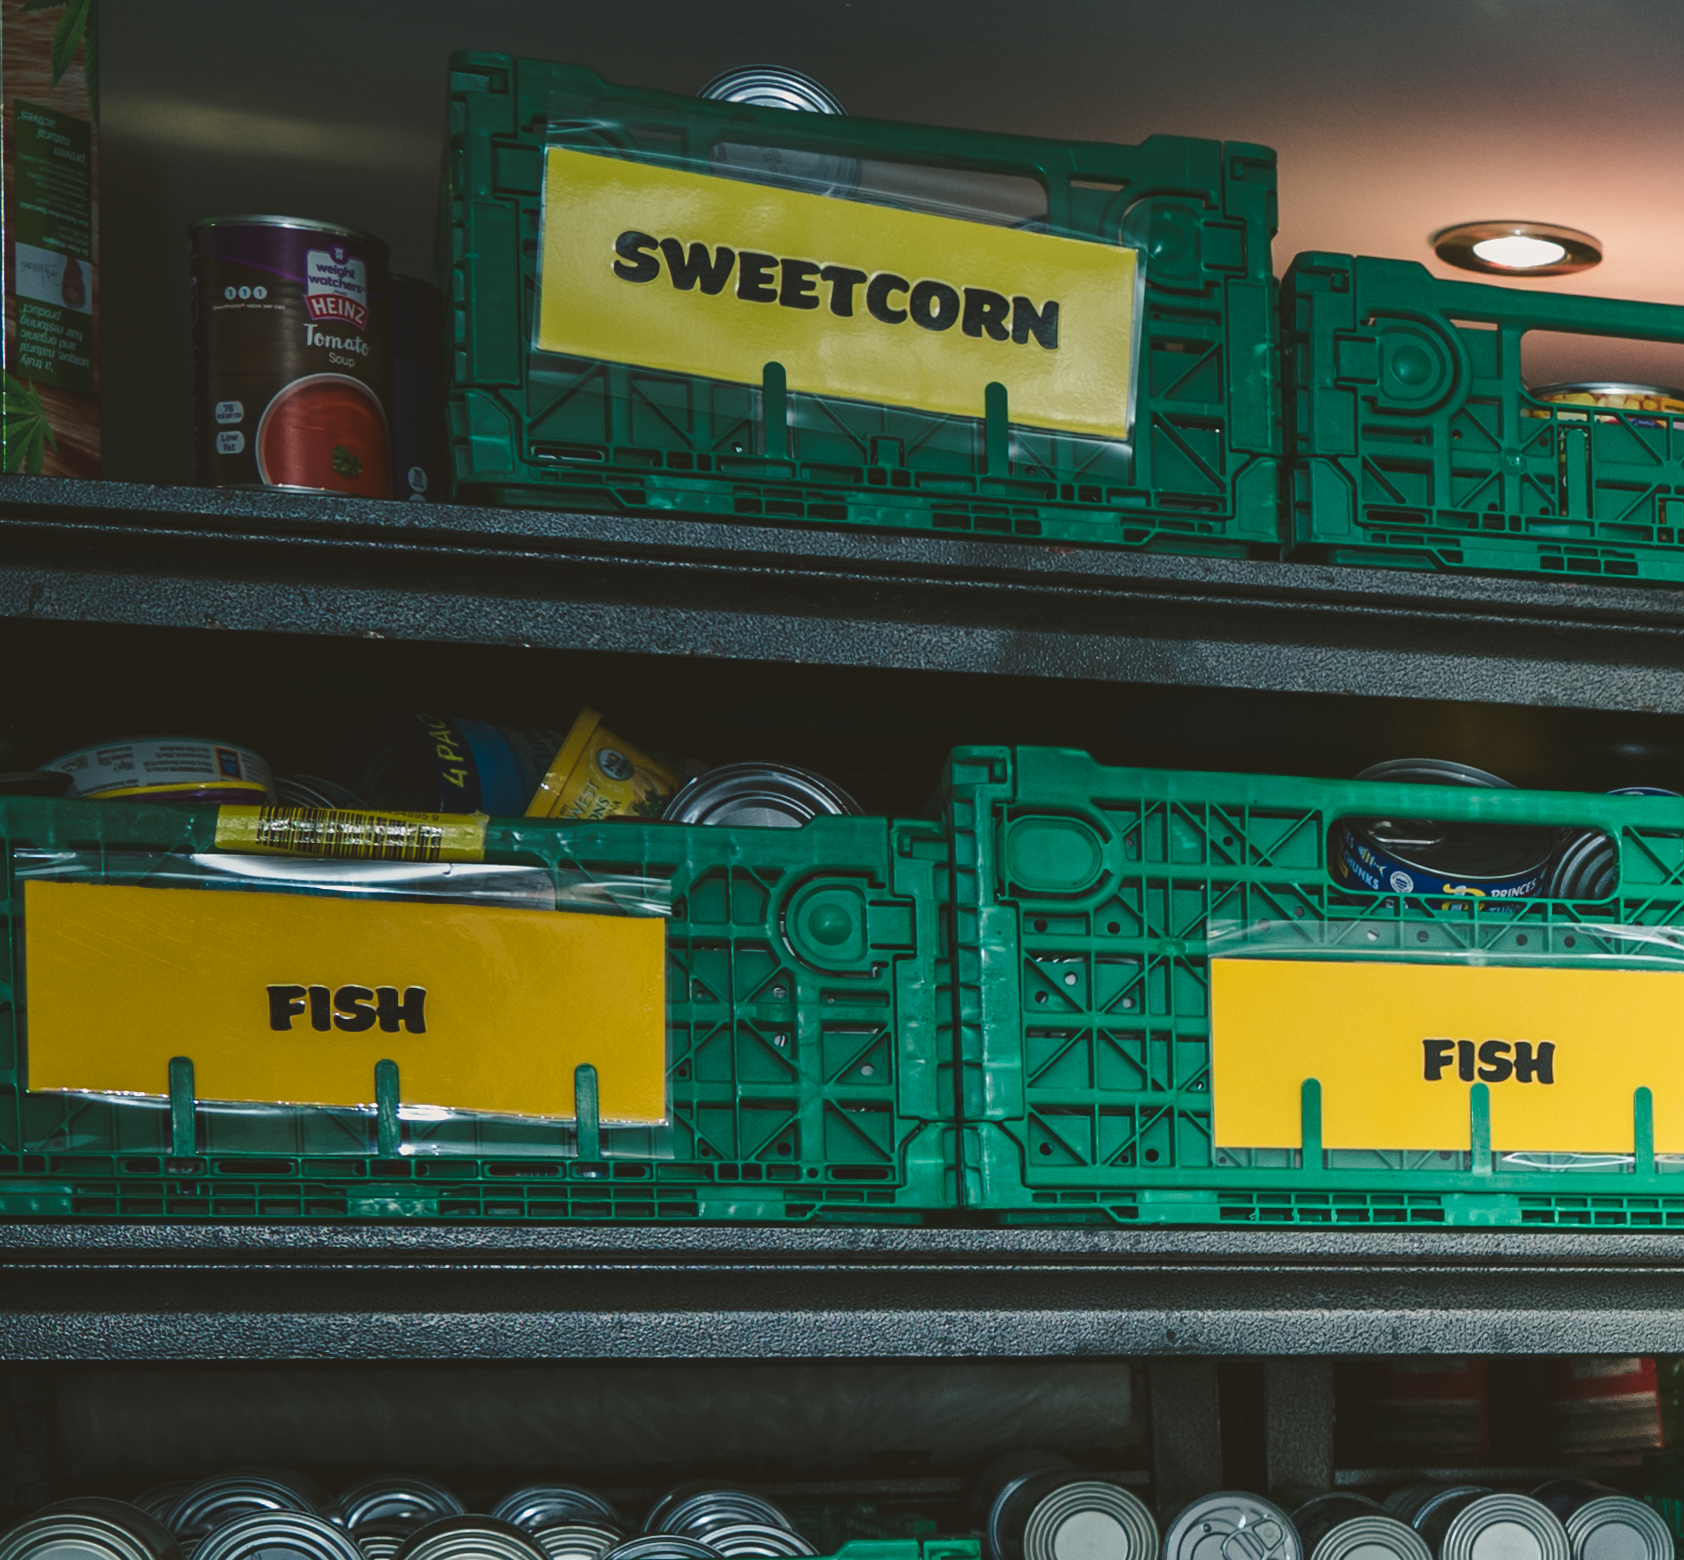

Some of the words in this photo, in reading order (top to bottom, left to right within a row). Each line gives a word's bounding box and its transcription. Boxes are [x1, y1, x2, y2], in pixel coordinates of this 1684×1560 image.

[36, 129, 70, 147] natural
[316, 262, 355, 279] weight
[308, 274, 362, 294] watchers
[612, 230, 1060, 350] SWEETCORN
[312, 299, 366, 325] HEINZ
[20, 314, 64, 336] restoring
[20, 328, 57, 347] organic
[58, 340, 76, 352] and
[64, 330, 83, 342] hair
[303, 323, 370, 356] Tomato
[20, 342, 56, 359] natural
[328, 352, 355, 368] Soup
[221, 433, 239, 442] Low
[224, 442, 236, 452] fat
[604, 751, 620, 772] NO
[442, 768, 468, 789] 4
[1343, 849, 1381, 891] CHUNKS
[1490, 878, 1538, 899] PRINCES
[266, 984, 428, 1035] FISH
[1421, 1038, 1556, 1086] FISH
